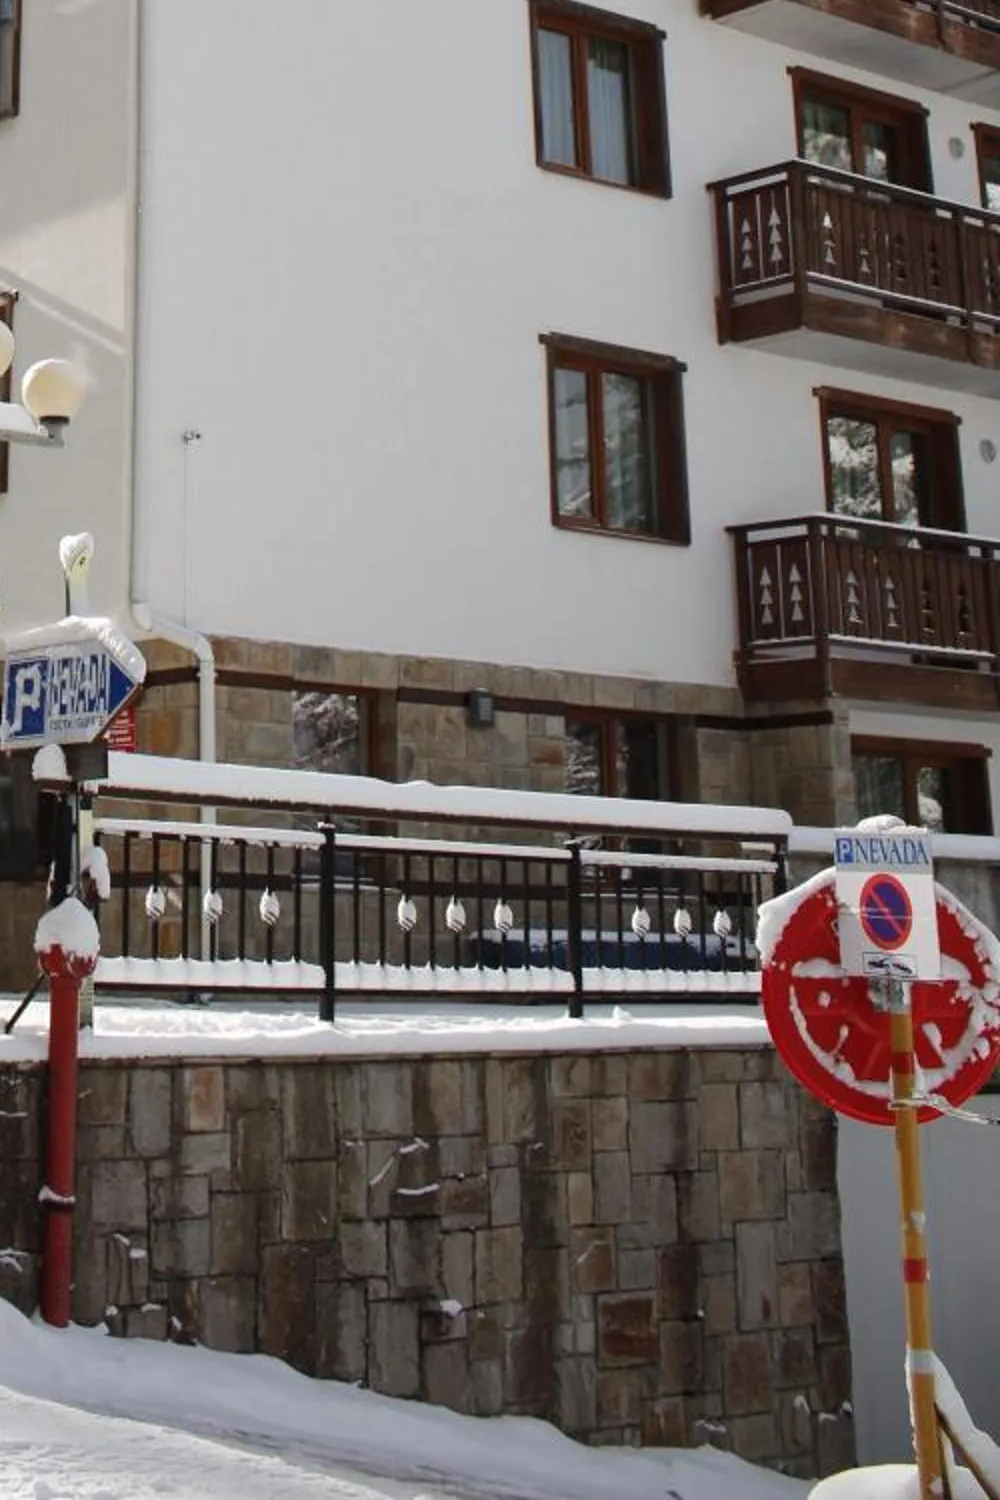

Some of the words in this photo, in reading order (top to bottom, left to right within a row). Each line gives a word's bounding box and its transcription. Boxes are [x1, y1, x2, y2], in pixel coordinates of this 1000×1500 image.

[13, 669, 41, 731] P
[50, 654, 109, 715] NEVADA
[839, 839, 851, 861] P
[855, 838, 929, 864] NEVADA
